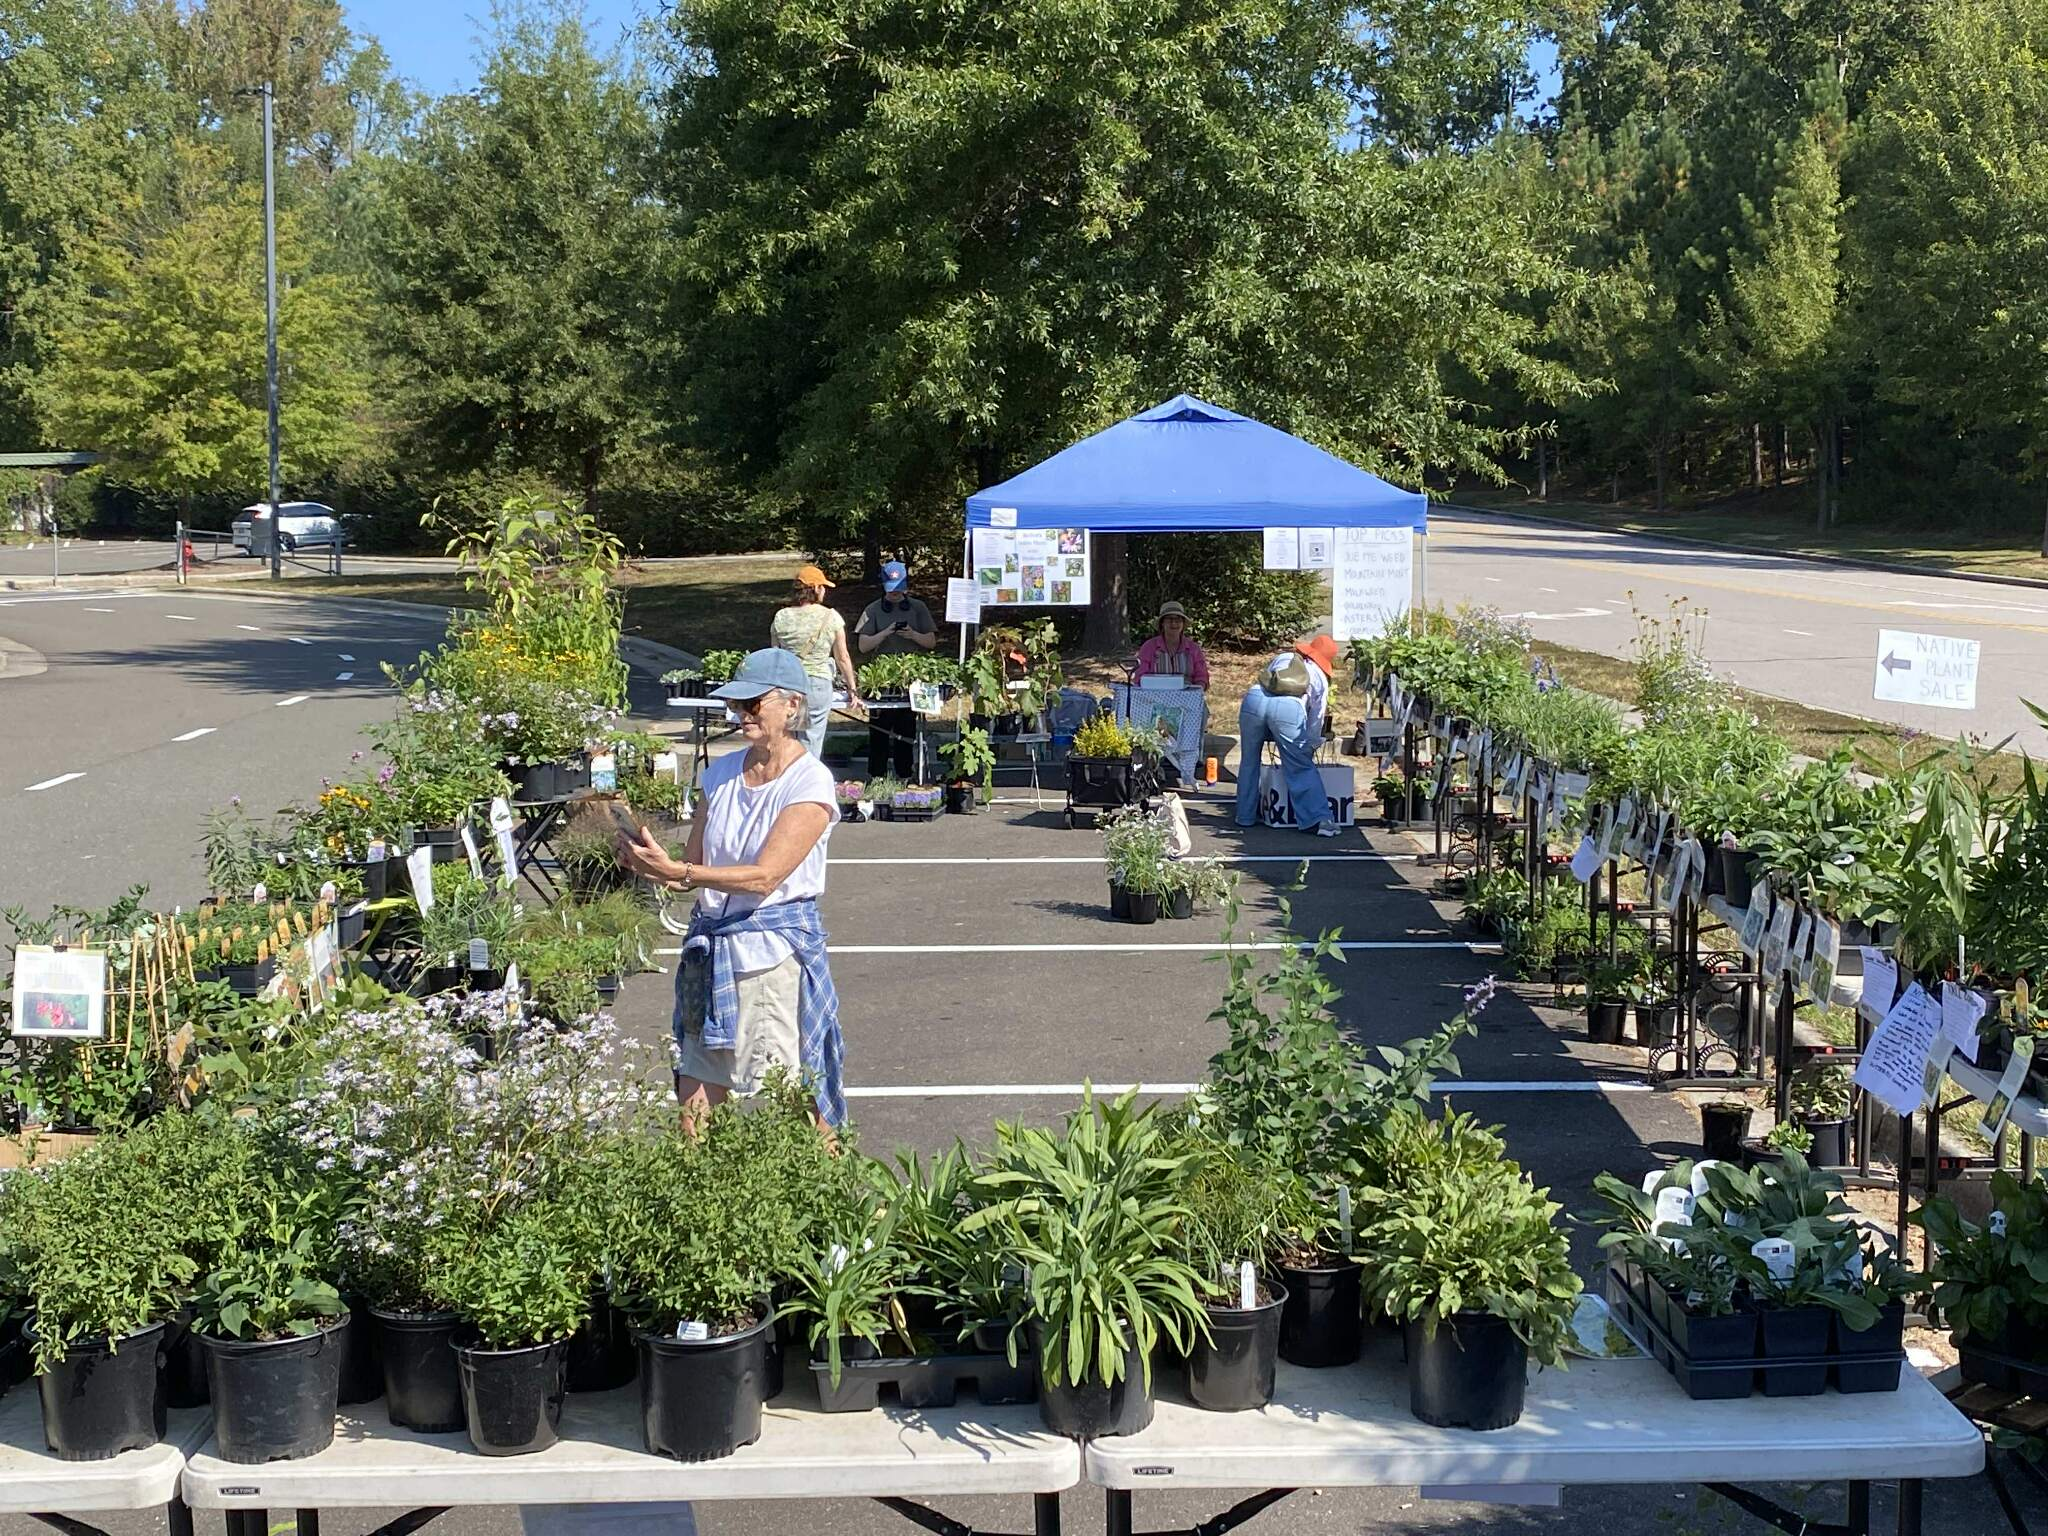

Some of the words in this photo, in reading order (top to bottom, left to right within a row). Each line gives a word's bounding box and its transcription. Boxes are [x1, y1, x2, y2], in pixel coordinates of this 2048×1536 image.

[1344, 528, 1368, 542] TOP
[1375, 529, 1406, 542] PICKS
[1344, 613, 1379, 624] ASTERS
[1916, 636, 1978, 660] NATIVE
[1926, 659, 1975, 681] PLANT
[1919, 679, 1969, 702] SALE
[222, 1487, 257, 1495] LIFETIME
